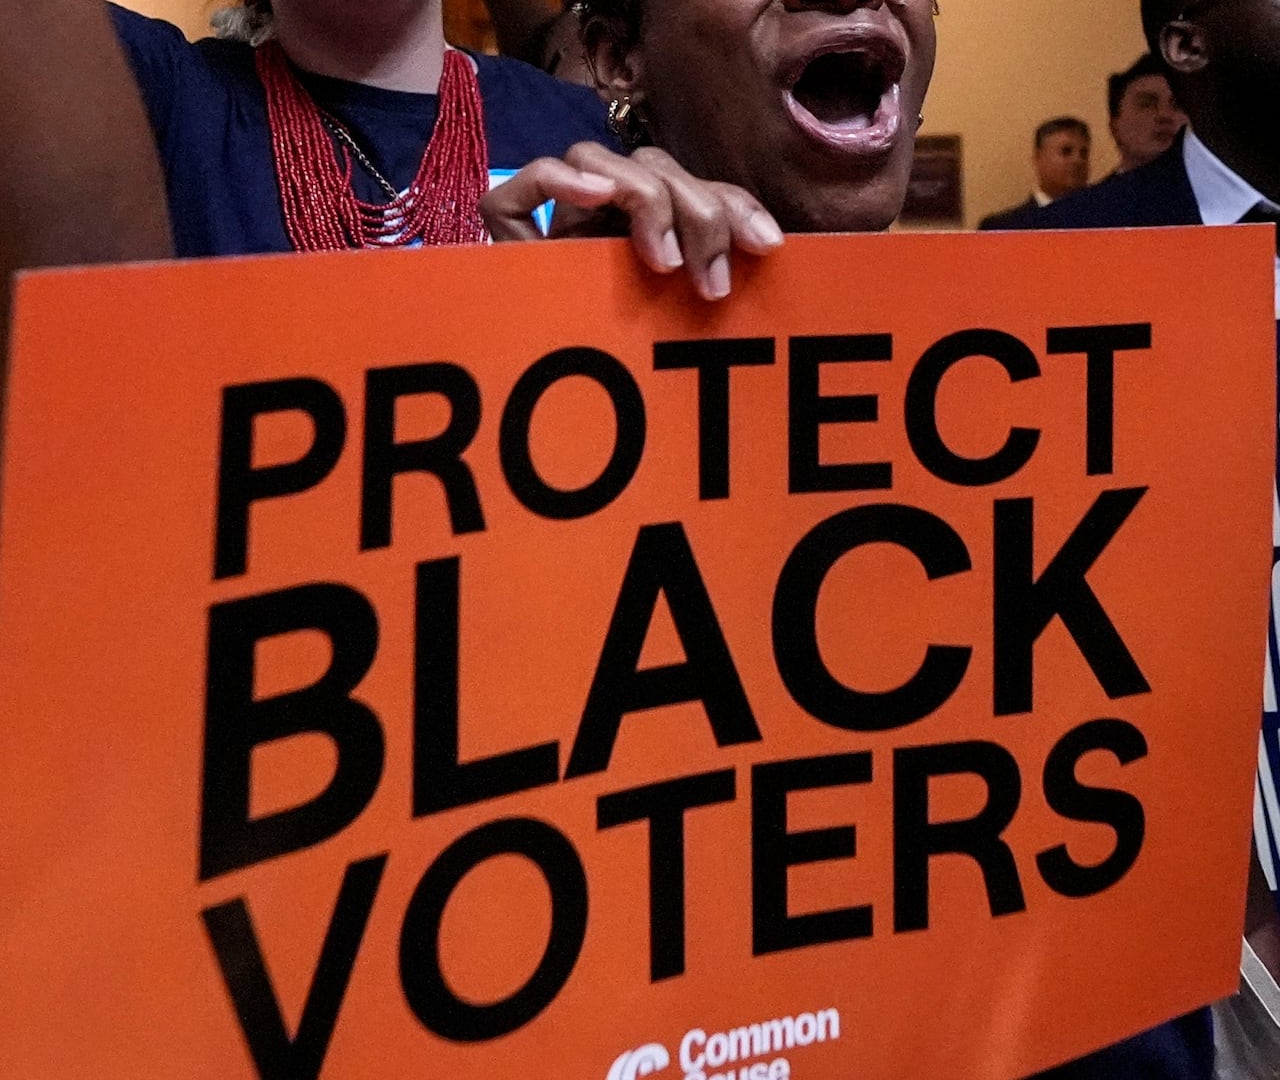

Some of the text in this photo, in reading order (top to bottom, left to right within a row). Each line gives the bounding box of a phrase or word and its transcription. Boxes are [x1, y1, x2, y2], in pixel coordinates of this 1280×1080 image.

[211, 322, 1153, 582] PROTECT
[196, 485, 1153, 884] BLACK
[199, 719, 1146, 1080] VOTERS
[679, 1007, 841, 1074] Common
